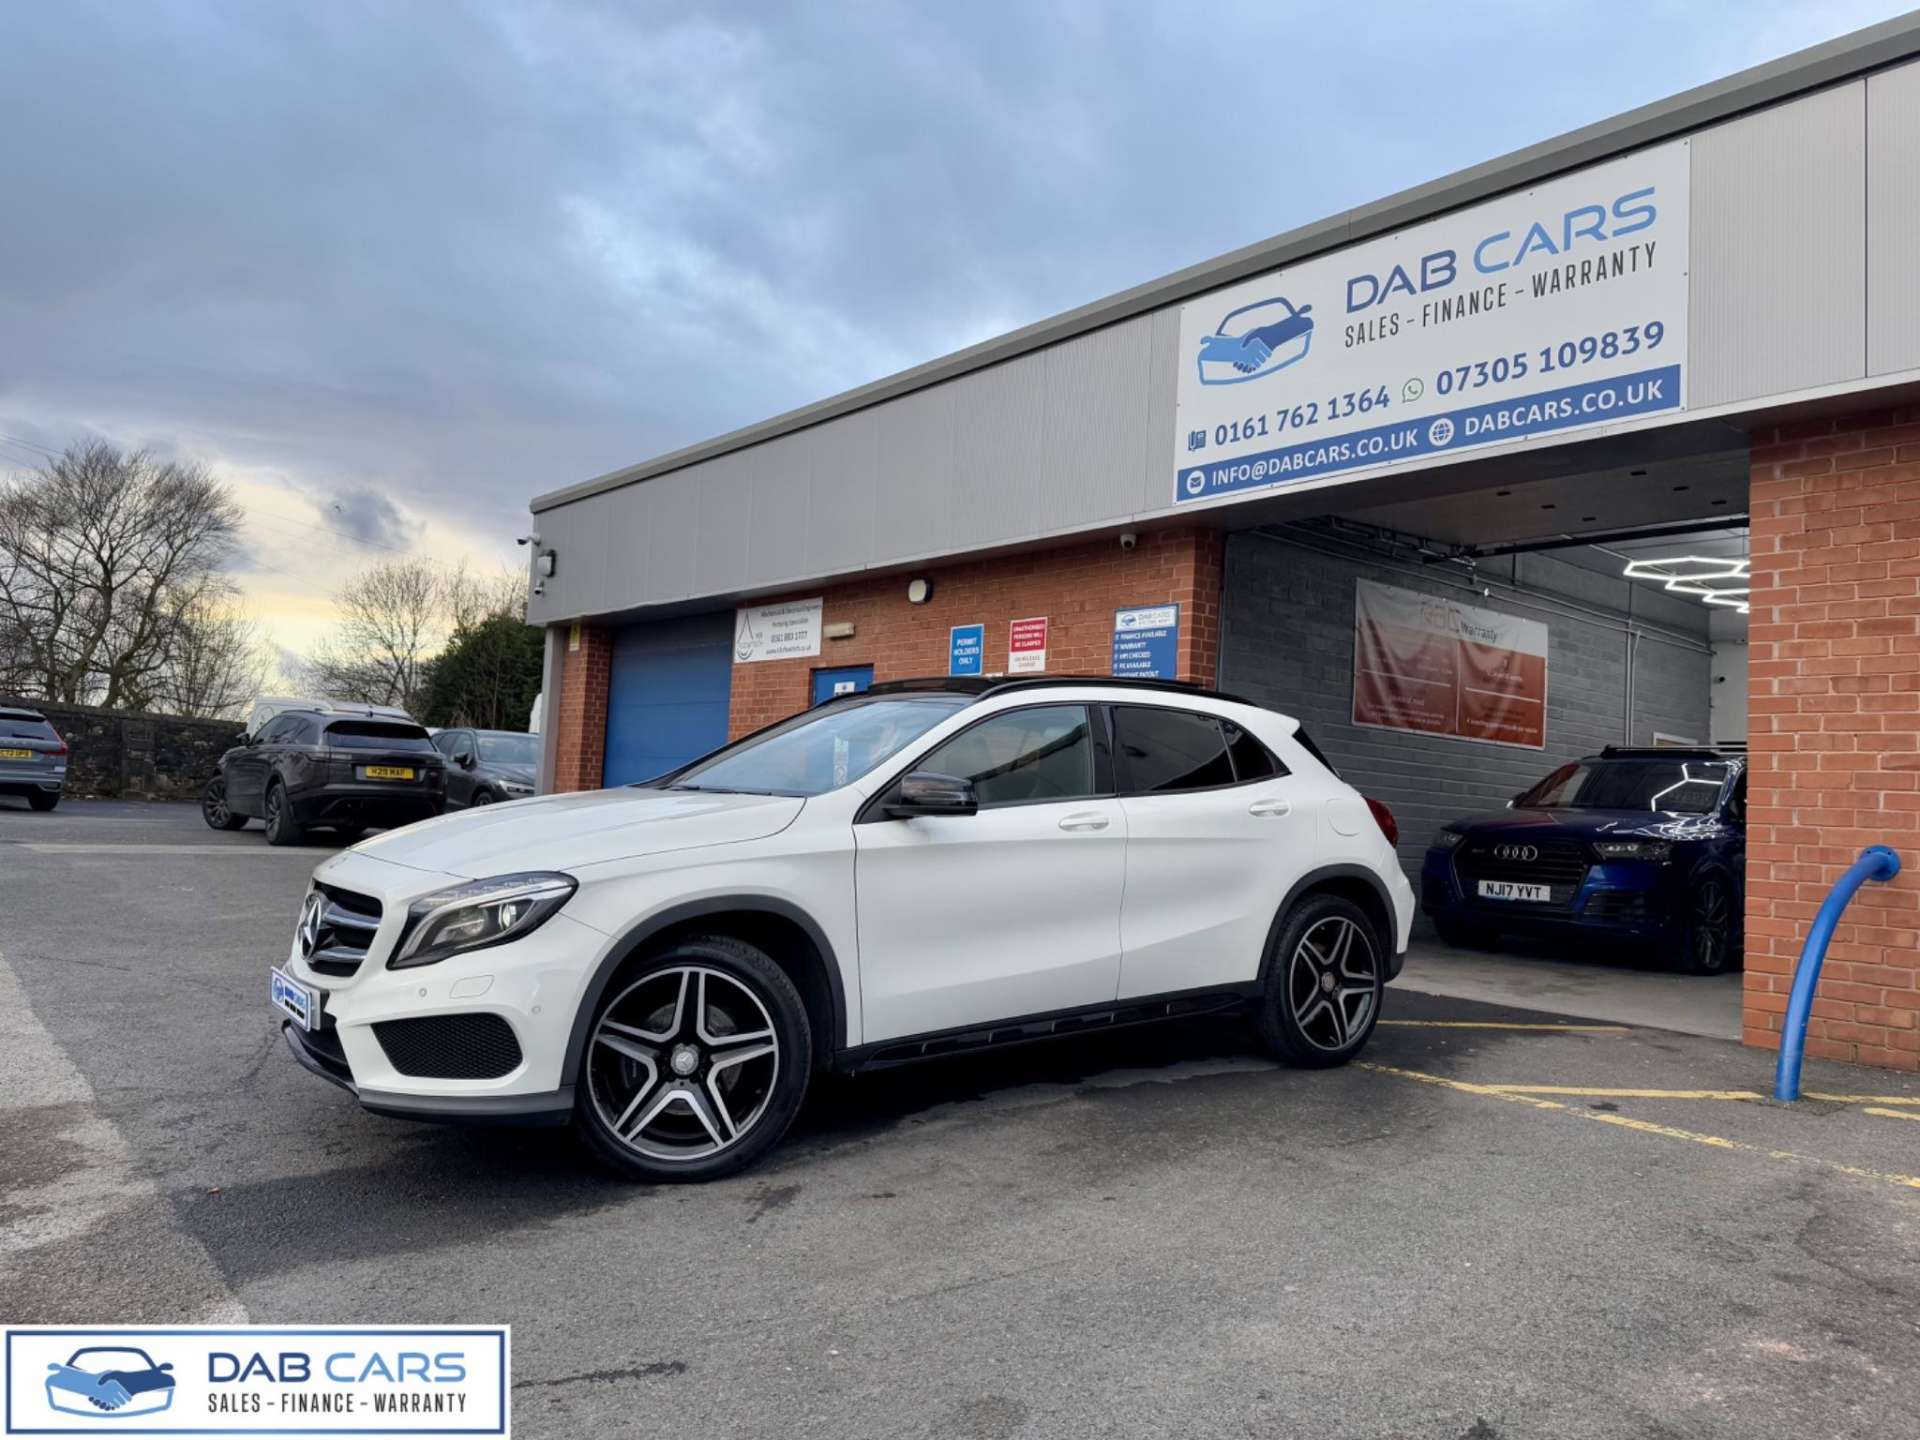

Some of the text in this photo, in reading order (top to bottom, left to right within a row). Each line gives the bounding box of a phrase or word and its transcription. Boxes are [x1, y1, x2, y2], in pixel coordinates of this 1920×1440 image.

[1346, 186, 1657, 314] DAB CARS
[1345, 312, 1400, 348] SALES
[1423, 283, 1508, 327] FINANCE
[1532, 241, 1657, 298] WARRANTY
[1436, 320, 1665, 395] 07305 109839
[1215, 385, 1390, 446] 0161 762 1364
[1465, 379, 1663, 436] DABCARS.CO.UK
[1212, 428, 1418, 487] INFO@DABCARS.CO.UK
[953, 647, 980, 656] HOLDERS
[957, 637, 977, 647] PERMIT
[958, 657, 974, 665] ONLY
[1486, 882, 1542, 899] NJ17 YVT
